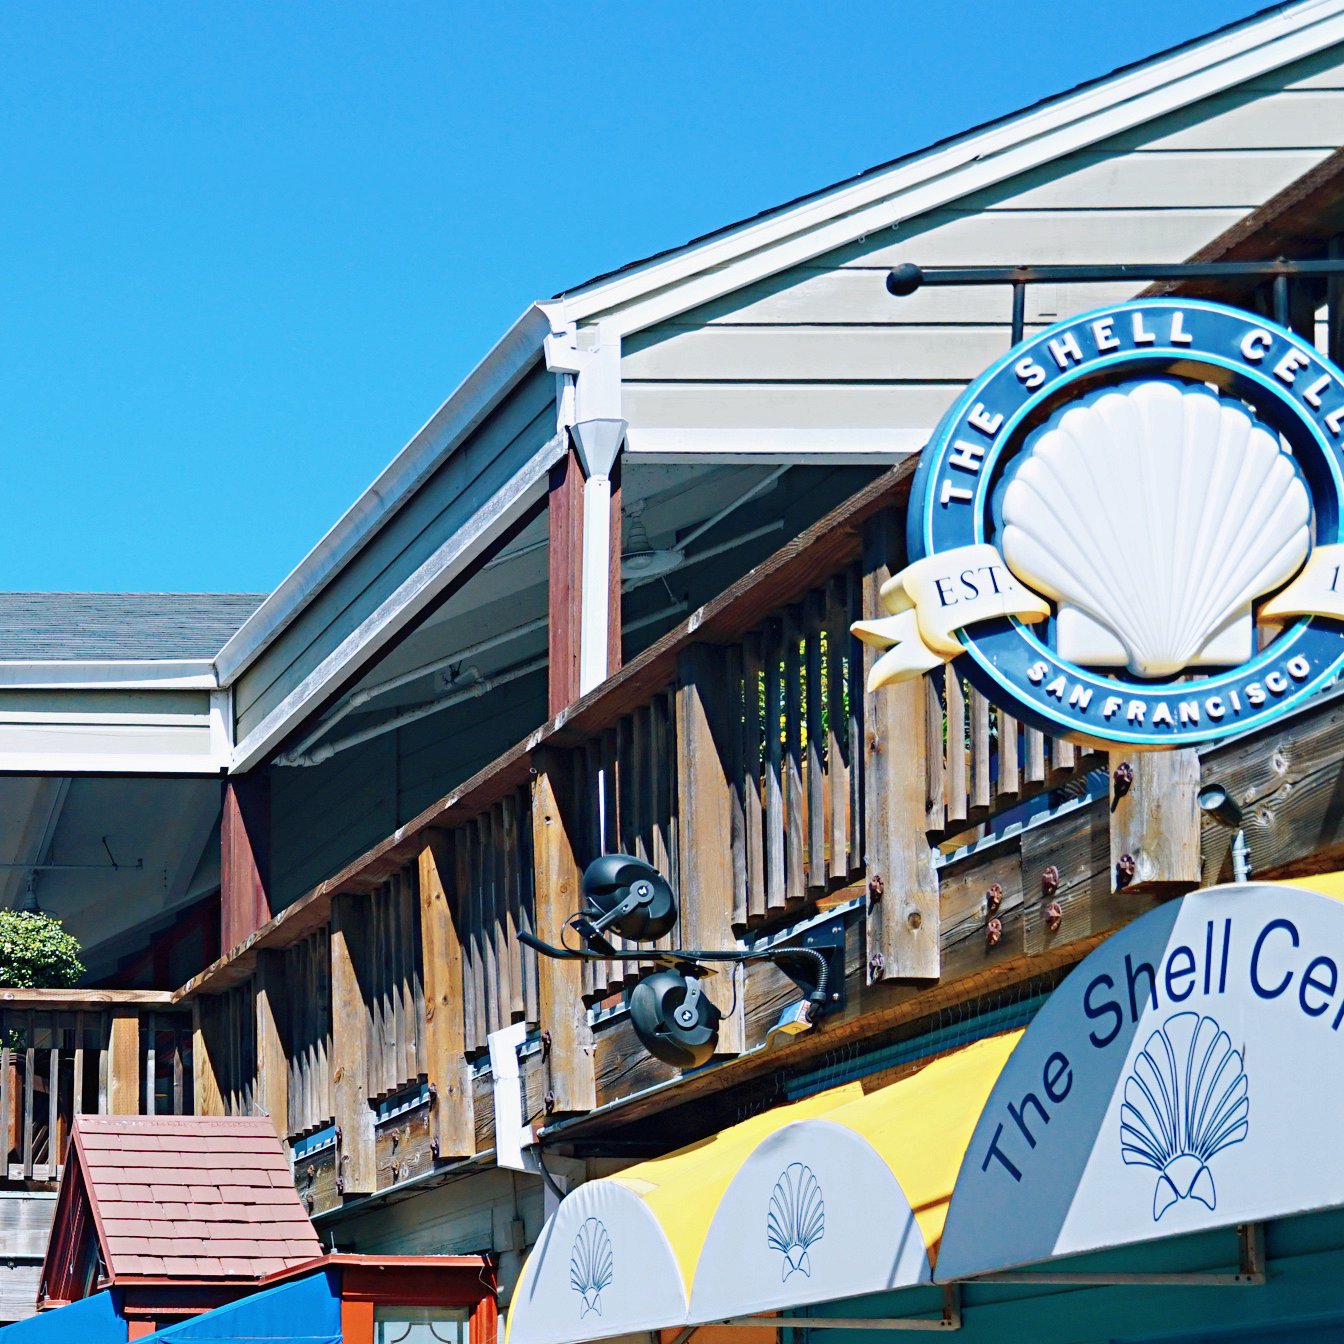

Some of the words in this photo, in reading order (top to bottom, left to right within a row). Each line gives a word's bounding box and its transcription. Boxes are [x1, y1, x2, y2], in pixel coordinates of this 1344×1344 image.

[941, 403, 1005, 506] THE
[1014, 311, 1193, 389] SHELL
[1239, 328, 1344, 450] CELL
[933, 565, 1014, 608] EST.
[1027, 659, 1093, 710] SAN
[1102, 652, 1311, 730] FRANCISCO
[981, 1050, 1073, 1183] The
[1083, 917, 1232, 1050] Shell
